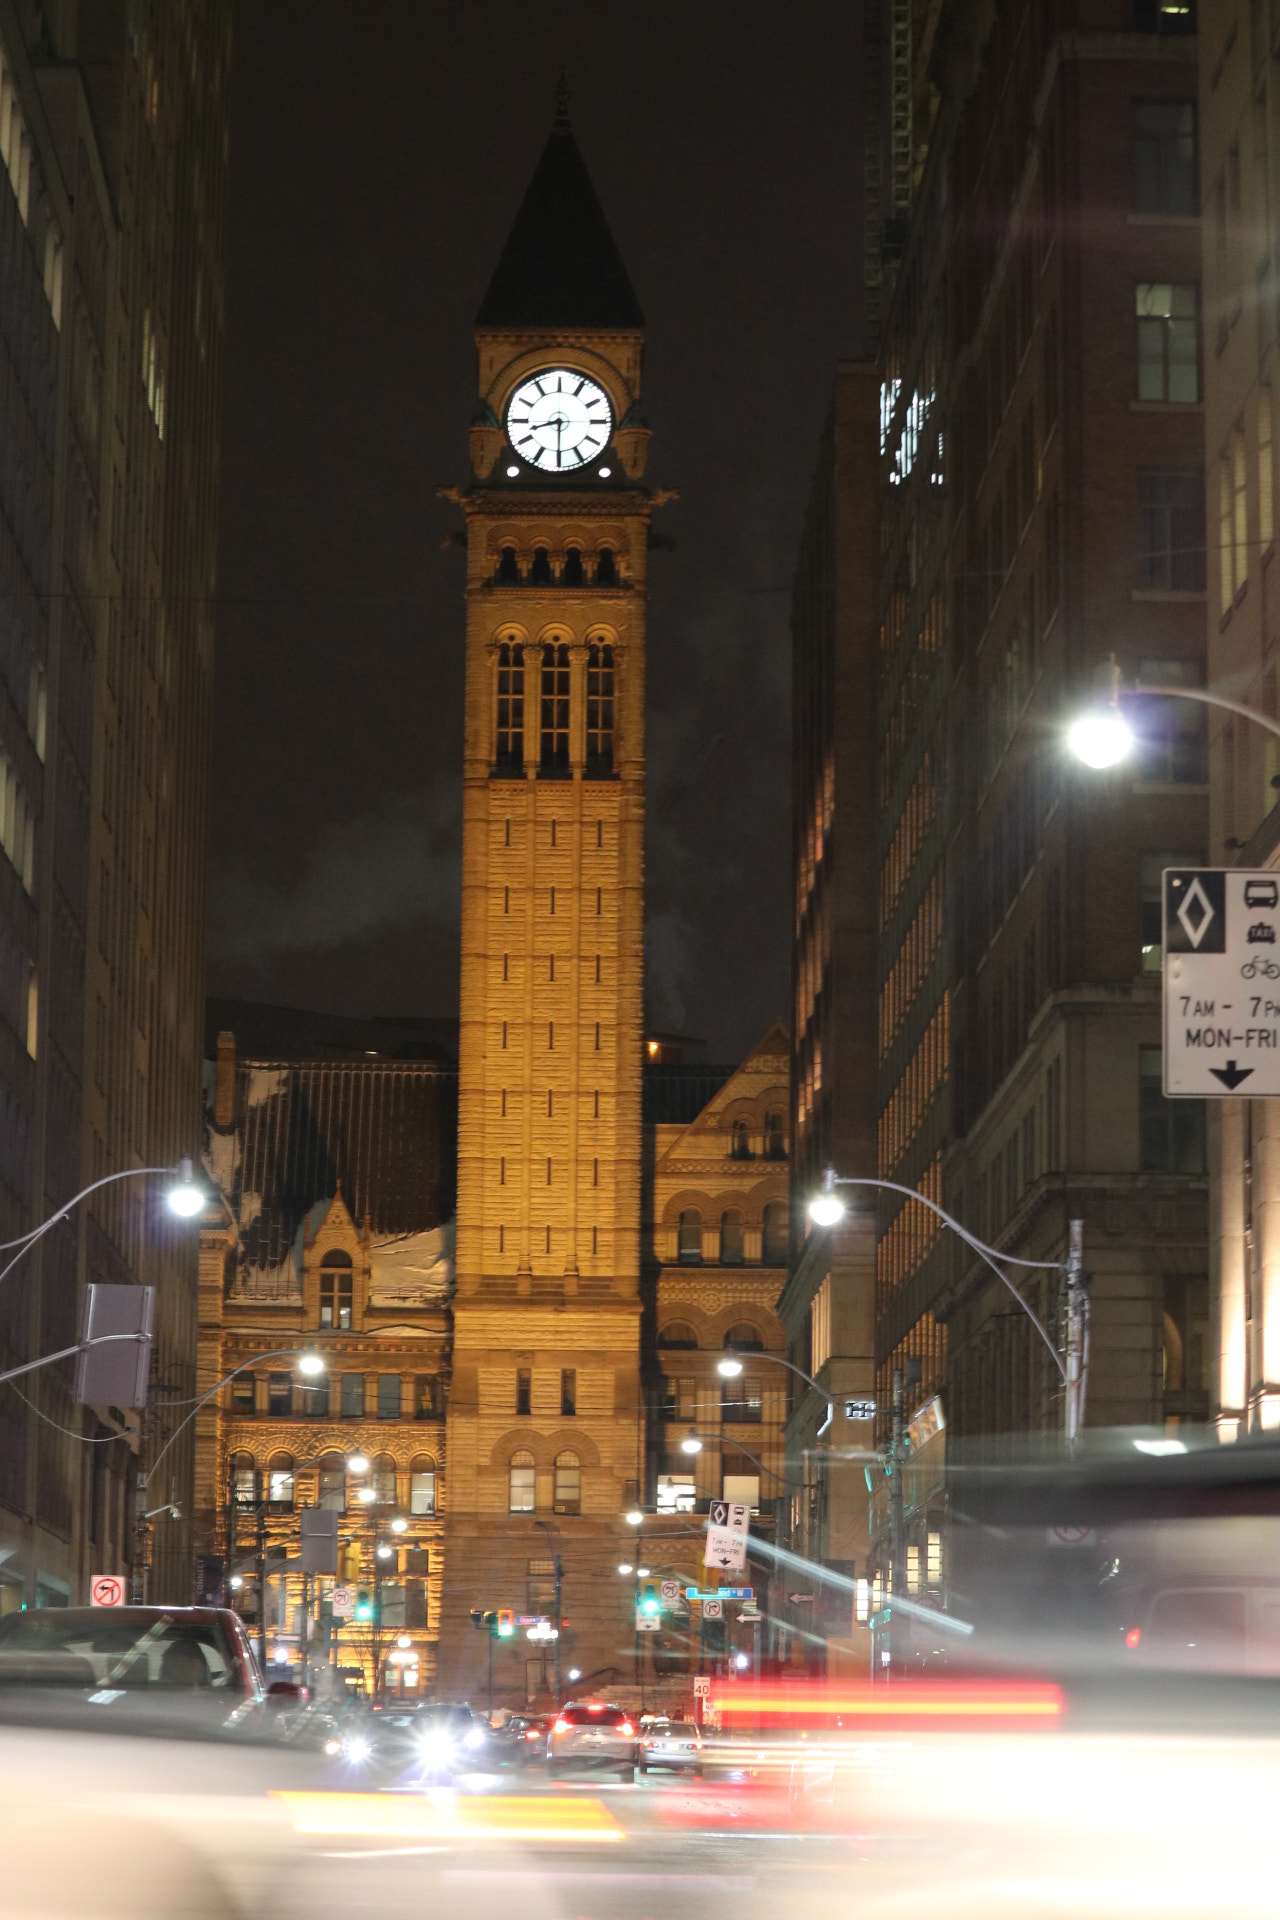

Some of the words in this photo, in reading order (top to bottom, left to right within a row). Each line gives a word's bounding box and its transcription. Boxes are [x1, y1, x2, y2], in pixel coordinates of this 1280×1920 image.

[1250, 928, 1272, 938] TAXI
[1179, 996, 1215, 1017] 7AM
[1186, 1028, 1277, 1048] MON-FRI
[695, 1685, 709, 1694] 40
